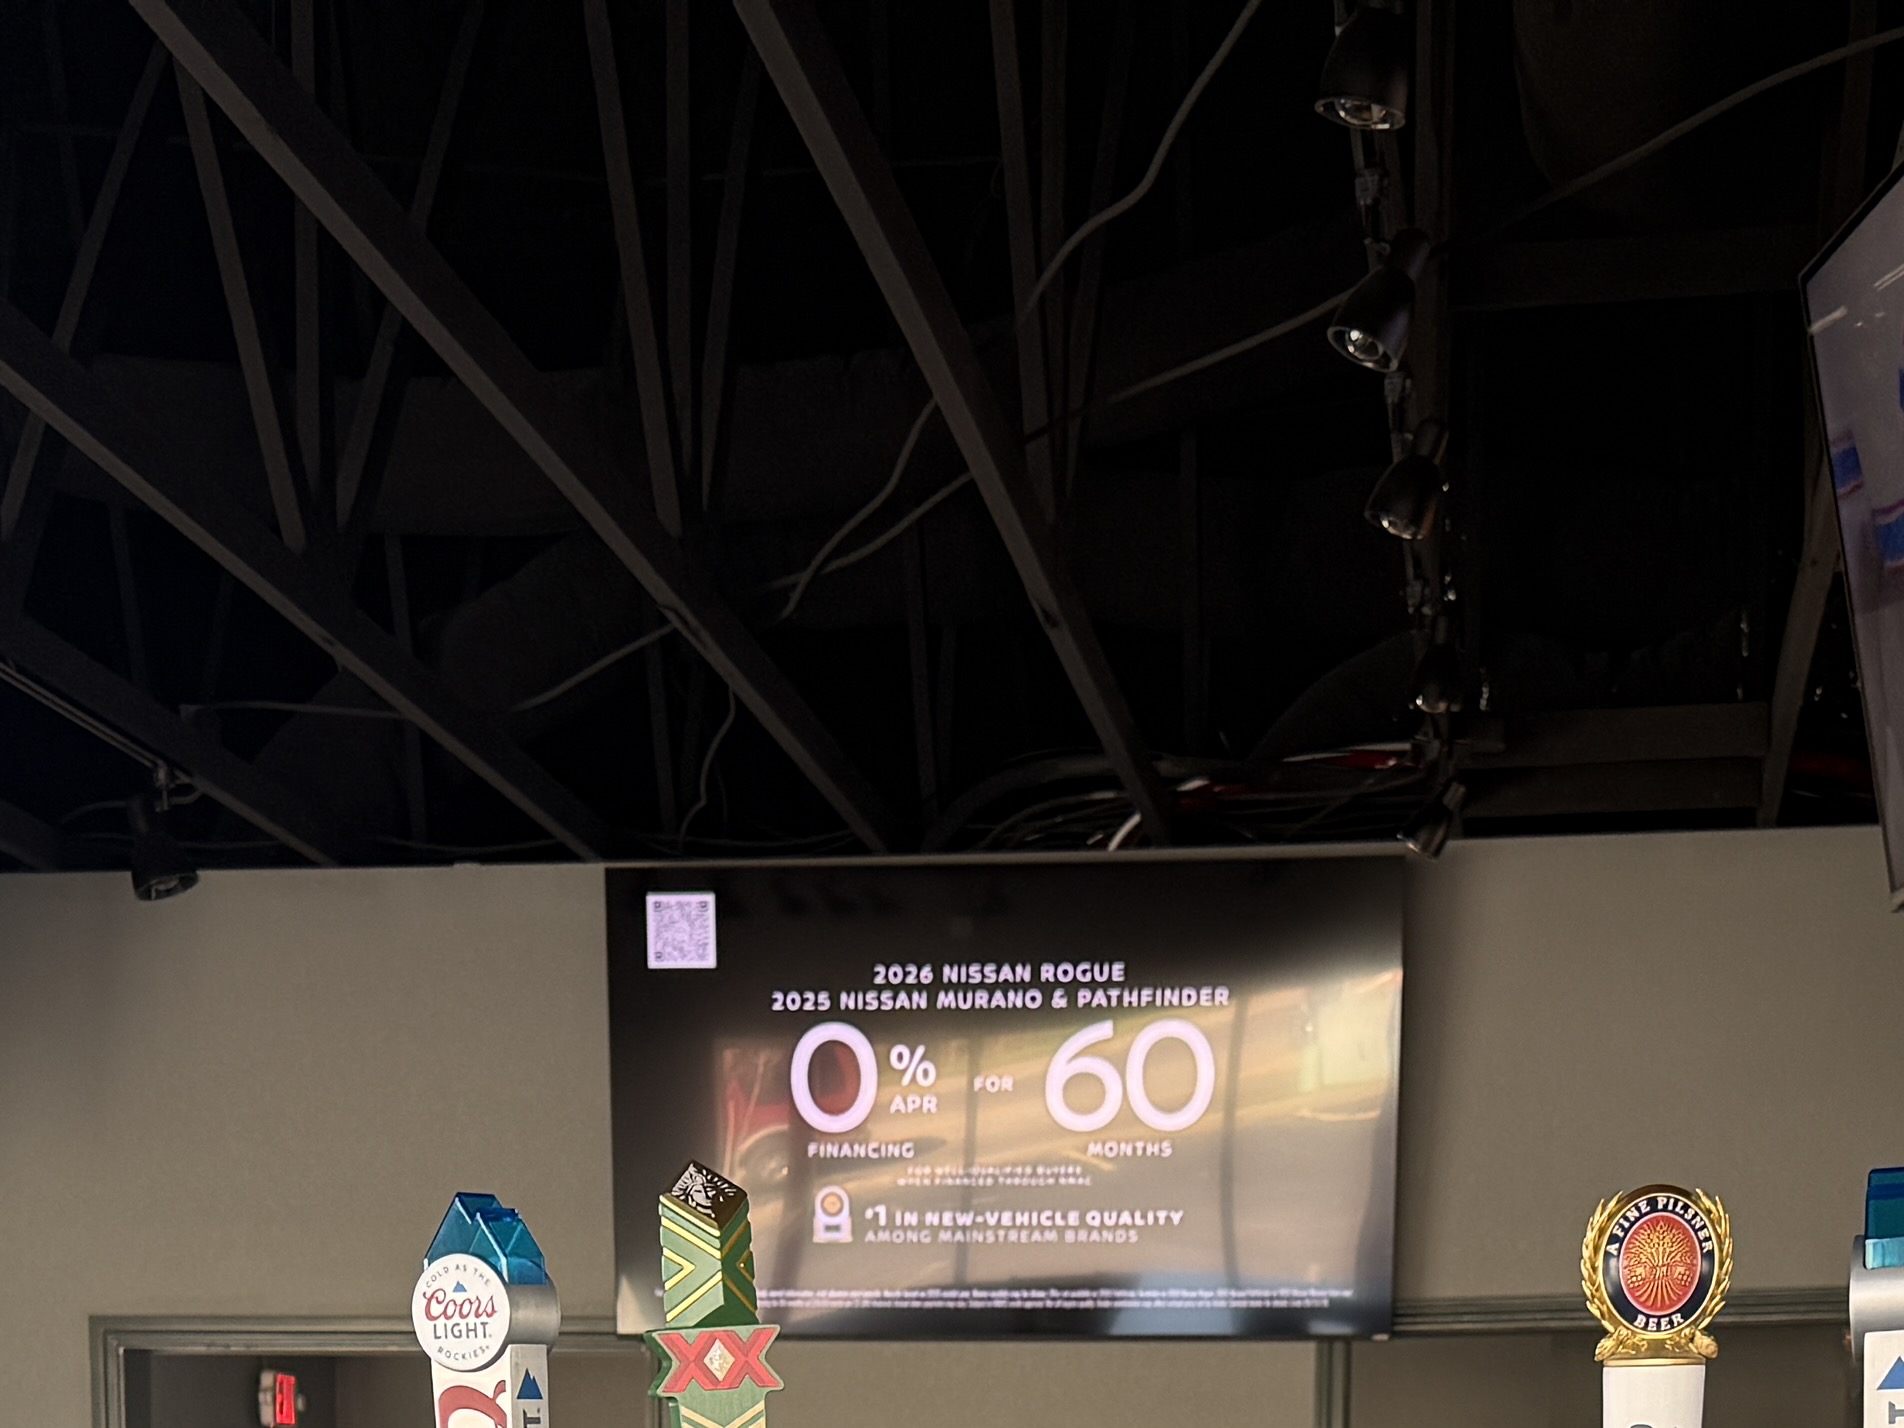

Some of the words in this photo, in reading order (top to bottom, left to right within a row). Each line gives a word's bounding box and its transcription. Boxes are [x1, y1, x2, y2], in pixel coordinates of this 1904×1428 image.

[873, 963, 934, 985] 2026
[942, 962, 1032, 984] NISSAN
[1040, 961, 1125, 983] ROGUE
[771, 990, 831, 1011] 2025
[839, 989, 928, 1011] NISSAN
[936, 987, 1043, 1010] MURANO
[1051, 987, 1067, 1009] &
[1077, 985, 1230, 1008] PATHFINDER
[973, 1074, 1014, 1093] FOR
[1045, 1017, 1216, 1132] 60
[889, 1095, 938, 1114] APR
[807, 1142, 915, 1159] FINANCING
[1087, 1140, 1173, 1158] MONTHS
[865, 1204, 887, 1227] #1
[895, 1210, 919, 1227] IN
[924, 1210, 1080, 1227] NEW-VEHICLE
[1085, 1209, 1185, 1228] QUALITY
[1606, 1242, 1620, 1256] A
[1613, 1199, 1651, 1238] FINE
[1655, 1196, 1715, 1253] PILSNER
[864, 1230, 932, 1244] AMONG
[938, 1229, 1058, 1243] MAINSTREAM
[1064, 1229, 1139, 1243] BRANDS
[426, 1266, 450, 1289] COLD
[455, 1263, 467, 1273] AS
[472, 1267, 492, 1286] THE
[422, 1287, 498, 1322] Coors
[433, 1321, 489, 1339] LIGHT
[1633, 1313, 1685, 1331] BEER
[437, 1345, 486, 1361] ROCKIES
[655, 1327, 780, 1393] XX
